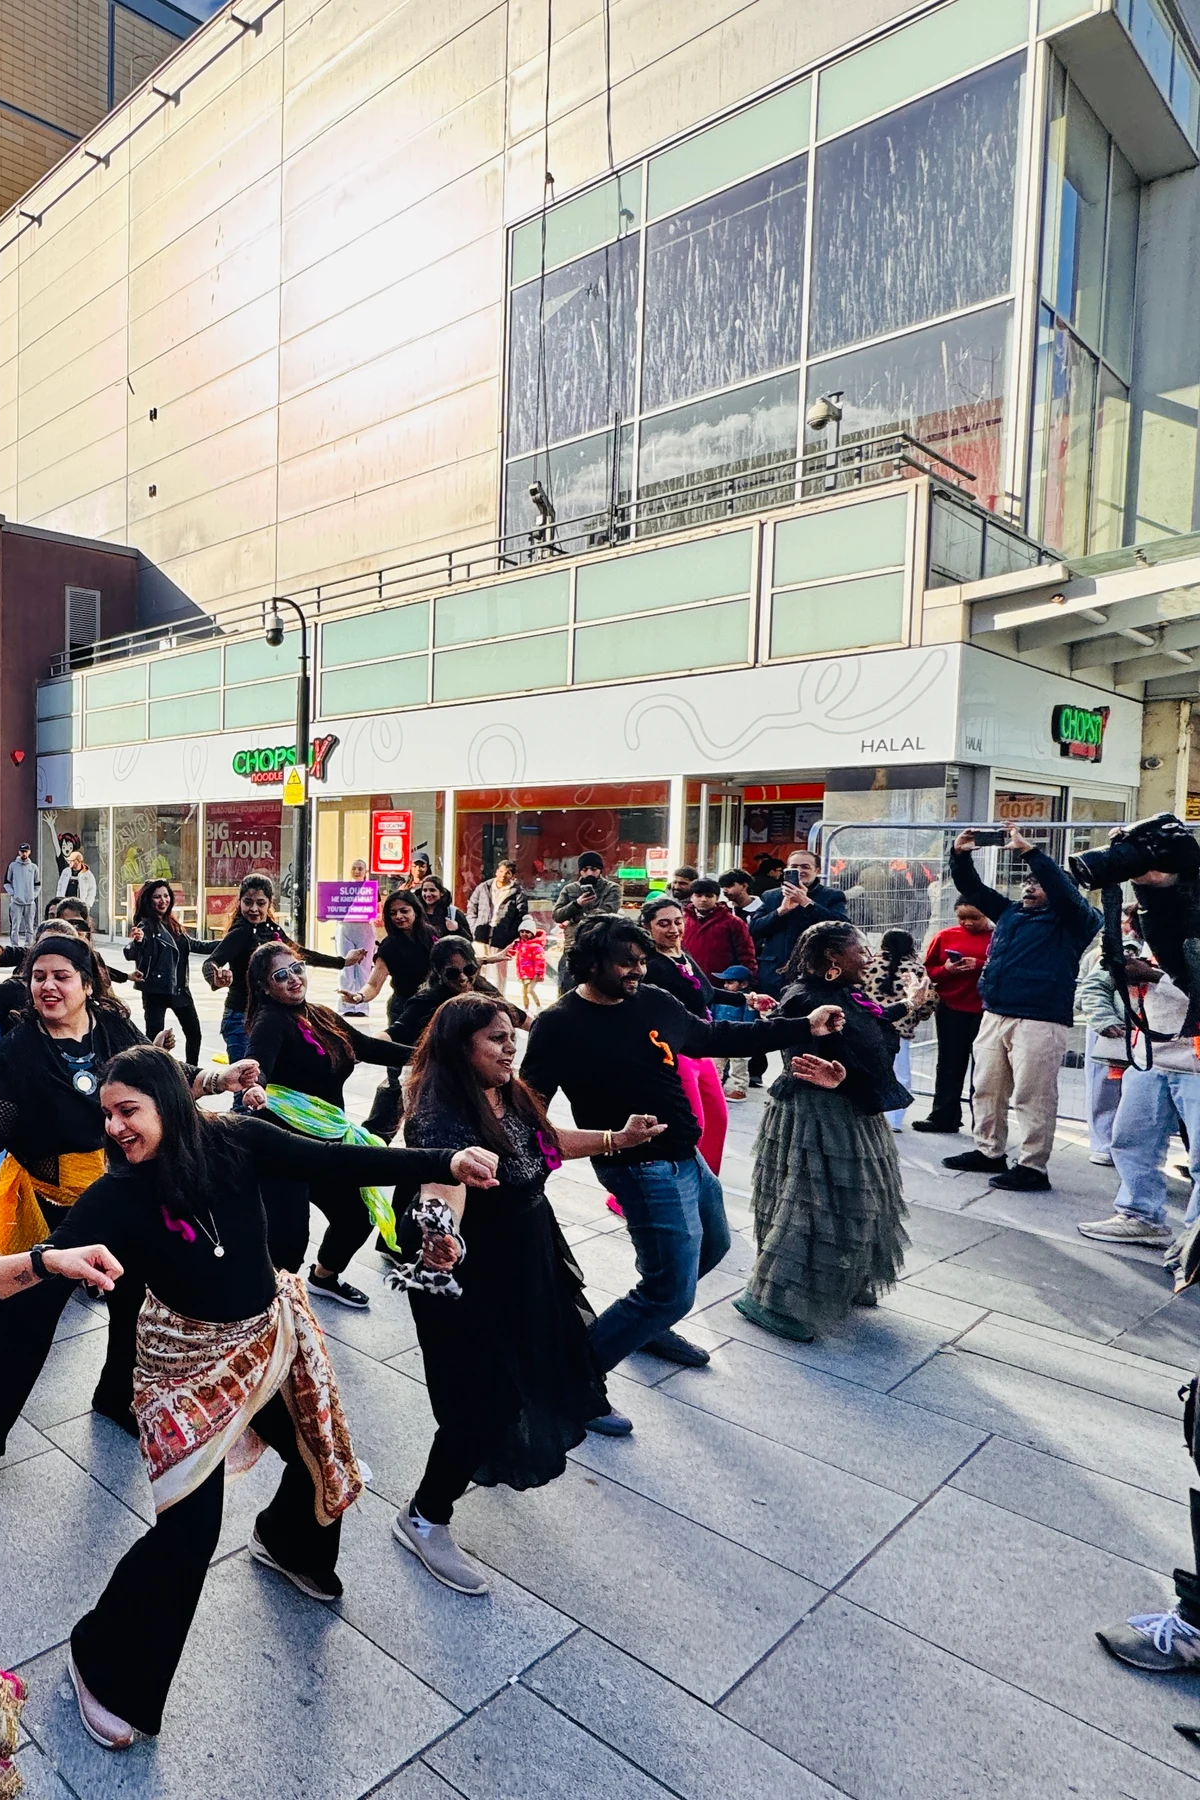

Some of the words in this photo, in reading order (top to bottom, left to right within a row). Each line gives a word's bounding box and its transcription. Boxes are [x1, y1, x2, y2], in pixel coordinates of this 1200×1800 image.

[861, 737, 925, 753] HALAL
[966, 736, 982, 752] HALAL
[233, 734, 337, 780] CHOPSIX
[206, 822, 230, 840] BIG
[206, 840, 274, 859] FLAVOUR
[340, 887, 373, 895] SLOUGH:
